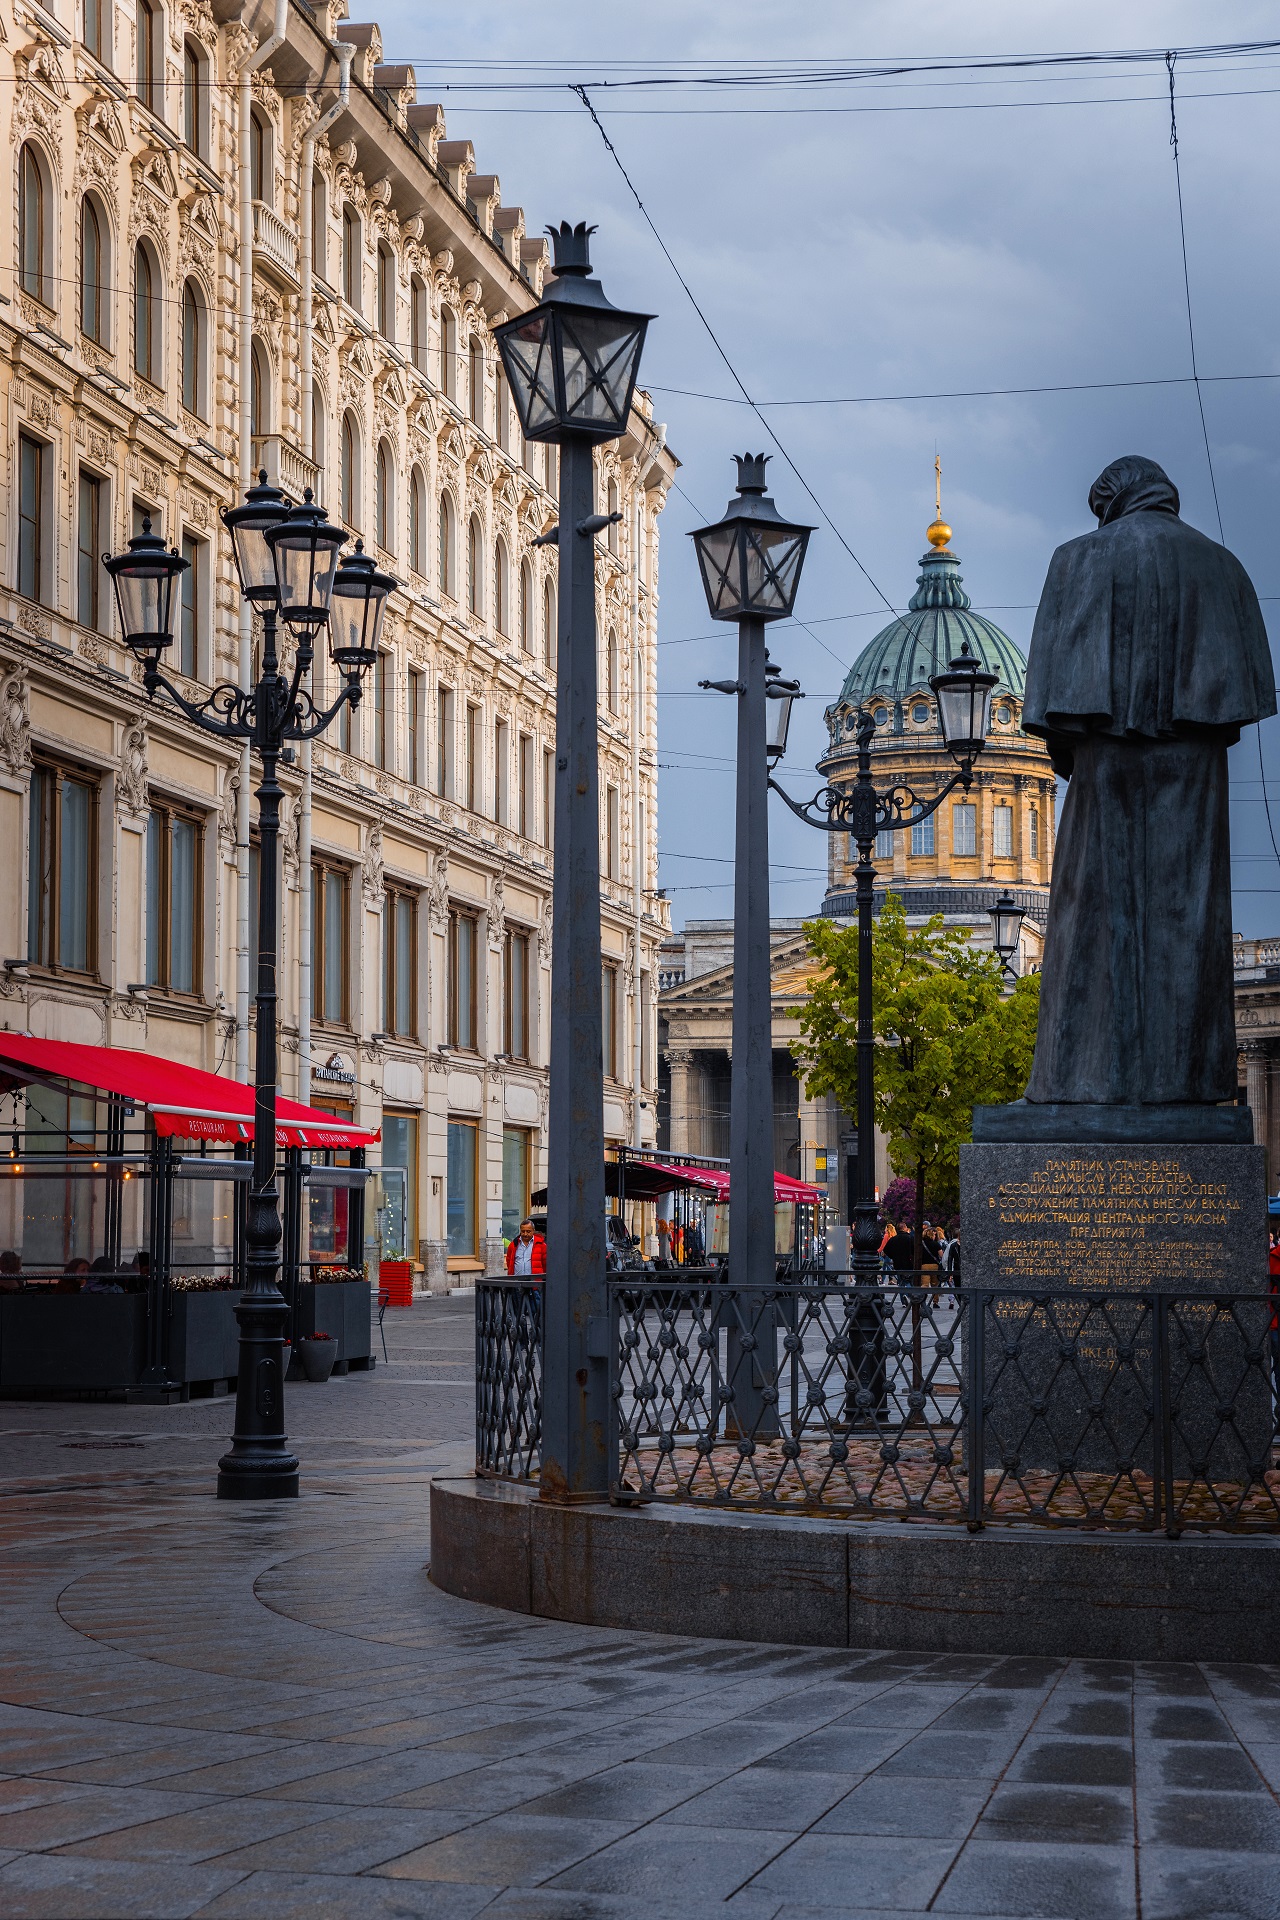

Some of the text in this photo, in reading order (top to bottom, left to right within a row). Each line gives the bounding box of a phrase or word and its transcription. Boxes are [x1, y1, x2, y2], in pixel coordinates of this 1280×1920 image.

[189, 1121, 226, 1135] RESTAURANT
[317, 1133, 352, 1143] RESTAURANT
[1046, 1160, 1180, 1171] ПАМЯТНИК УСТАНОВЛЕН
[1033, 1171, 1193, 1183] ПО ЗАМЫСЛУ И НА СРЕДСТВА
[998, 1183, 1074, 1194] АССОЦИАЦИИ
[1167, 1184, 1227, 1195] ПРОСПЕКТ
[988, 1197, 996, 1208] В
[1000, 1197, 1079, 1208] СООРУЖЕНИЕ
[1083, 1198, 1149, 1209] ПАМЯТНИКА
[1153, 1198, 1197, 1209] ВНЕСЛИ
[999, 1212, 1091, 1223] АДМИНИСТРАЦИЯ
[1094, 1212, 1180, 1224] ЦЕНТРАЛЬНОГО
[1070, 1226, 1146, 1238] ПРЕДПРИЯТИЯ
[1068, 1276, 1109, 1285] РЕСТОРАН
